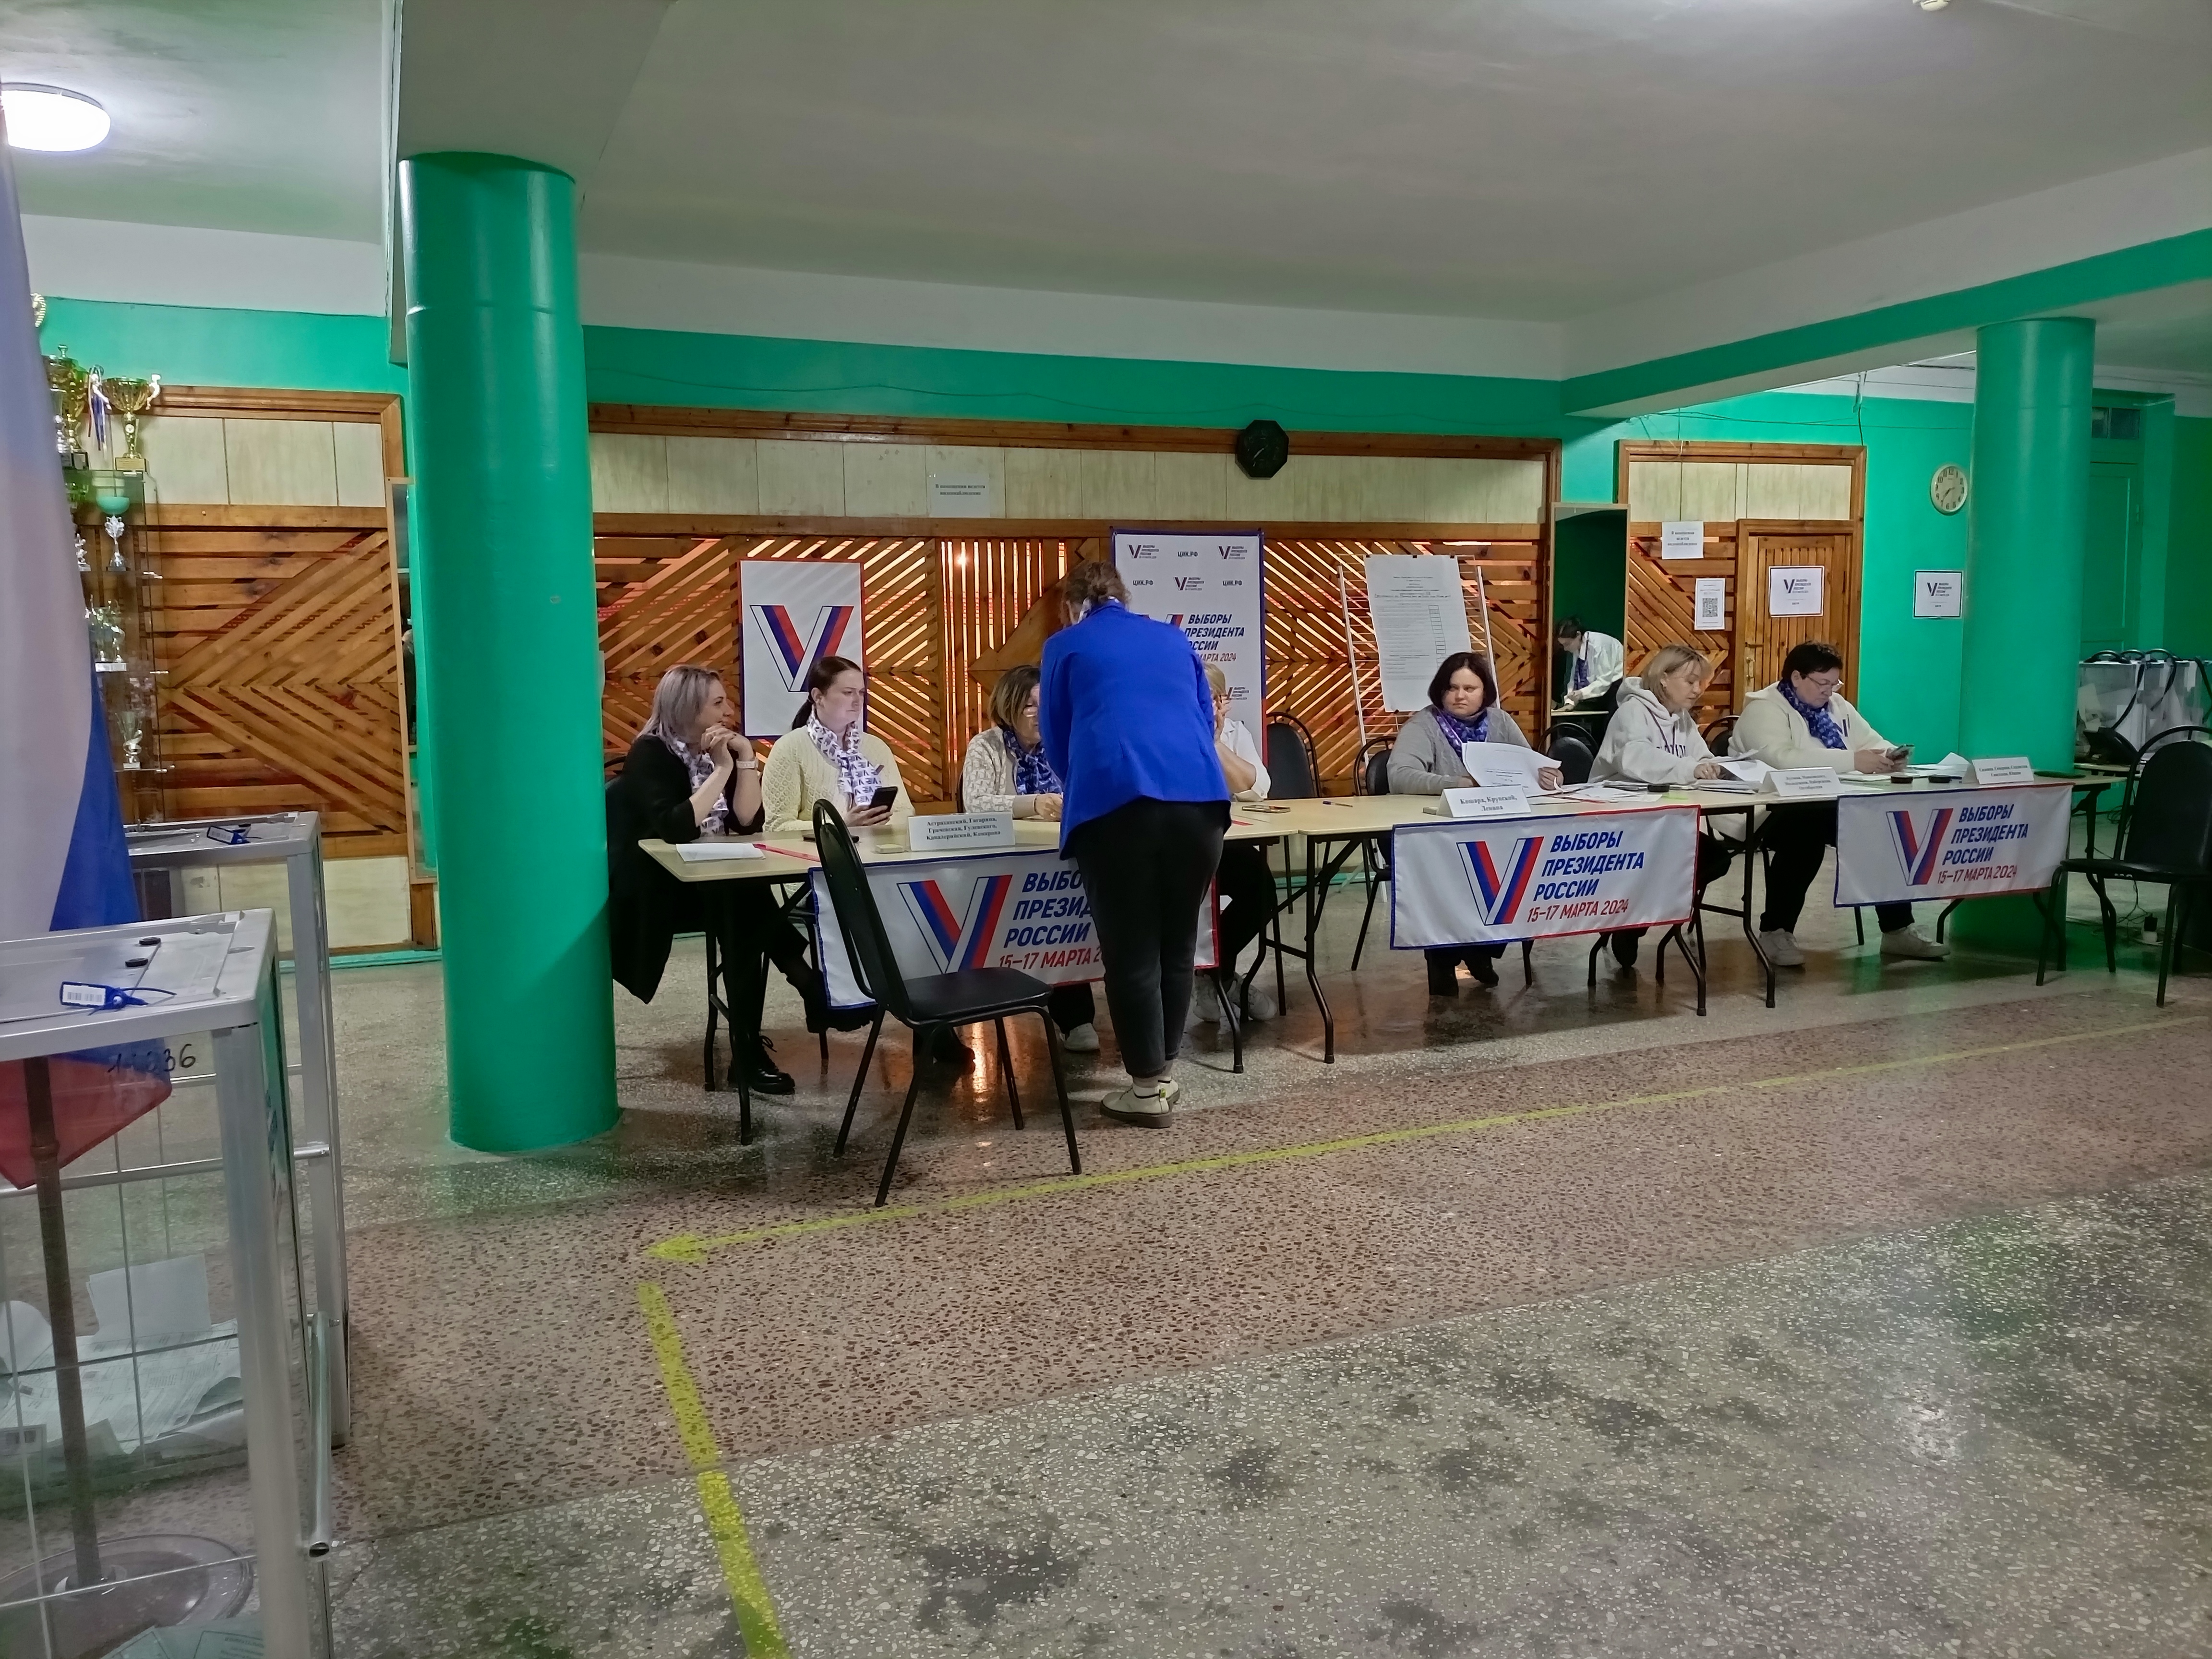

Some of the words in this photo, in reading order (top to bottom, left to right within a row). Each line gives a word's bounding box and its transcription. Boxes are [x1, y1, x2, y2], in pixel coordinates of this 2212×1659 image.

[1188, 614, 1232, 624] ВЫБОРЫ
[1185, 627, 1245, 638] ПРЕЗИДЕНТА
[1188, 640, 1219, 650] ССИИ
[1219, 653, 1237, 662] 2024
[1959, 804, 2014, 822] ВЫБОРЫ
[1550, 830, 1623, 853] ВЫБОРЫ
[1951, 824, 2029, 844] ПРЕЗИДЕНТА
[1541, 852, 1644, 877] ПРЕЗИДЕНТА
[1942, 847, 1994, 866] РОССИИ
[1022, 869, 1082, 893] ВЫБО
[1964, 866, 1993, 881] МАРТА
[1993, 865, 2018, 879] 2024
[1533, 878, 1599, 901] РОССИИ
[1013, 896, 1092, 920] ПРЕЗИД
[1559, 901, 1599, 919] МАРТА
[1600, 899, 1629, 915] 2024
[1003, 922, 1091, 948] РОССИИ
[1040, 948, 1091, 969] МАРТА
